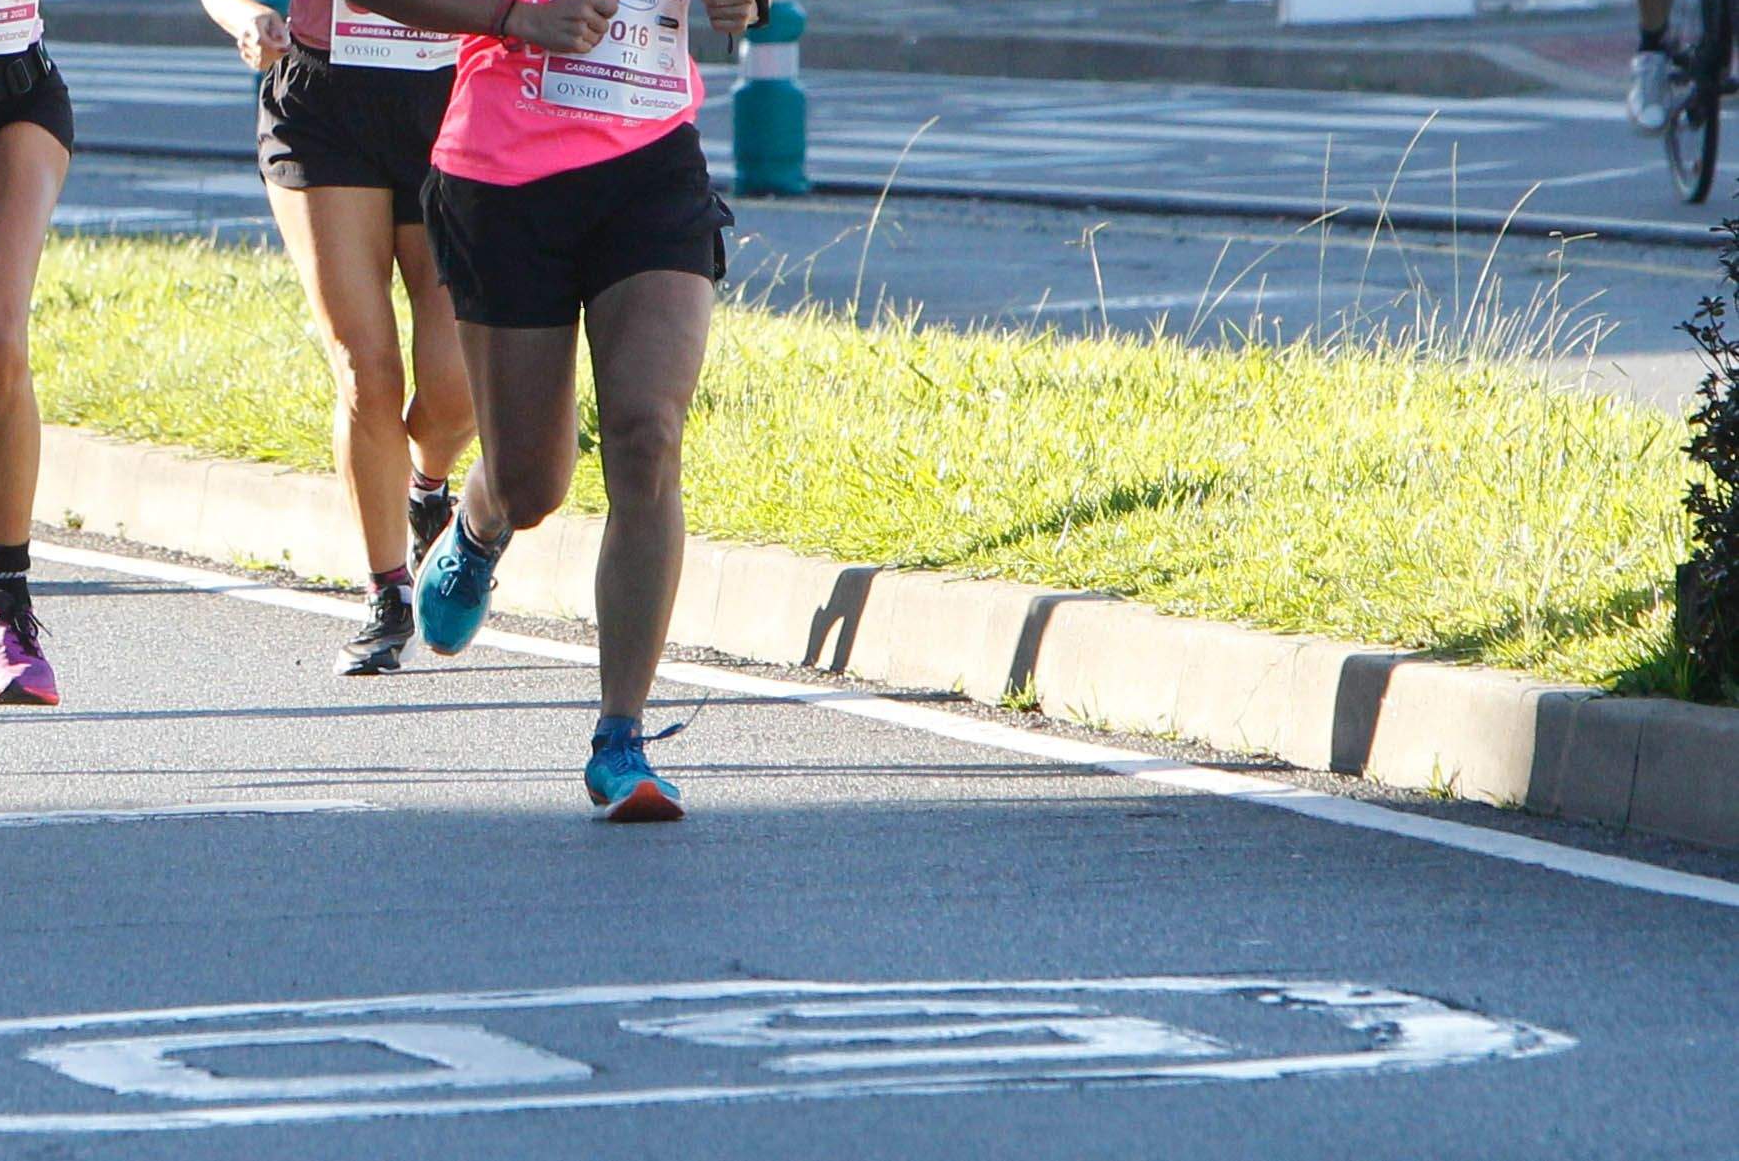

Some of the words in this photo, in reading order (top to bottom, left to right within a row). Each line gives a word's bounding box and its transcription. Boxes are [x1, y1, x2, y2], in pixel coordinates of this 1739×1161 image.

[349, 26, 391, 37] CARRERA
[393, 29, 405, 38] DE
[406, 30, 419, 38] LA
[610, 20, 649, 47] 016
[344, 44, 391, 57] OYSHO
[621, 50, 639, 65] 174
[564, 62, 611, 77] CARRERA
[612, 69, 624, 79] DE
[557, 82, 610, 101] OYSHO
[639, 96, 683, 110] Santander
